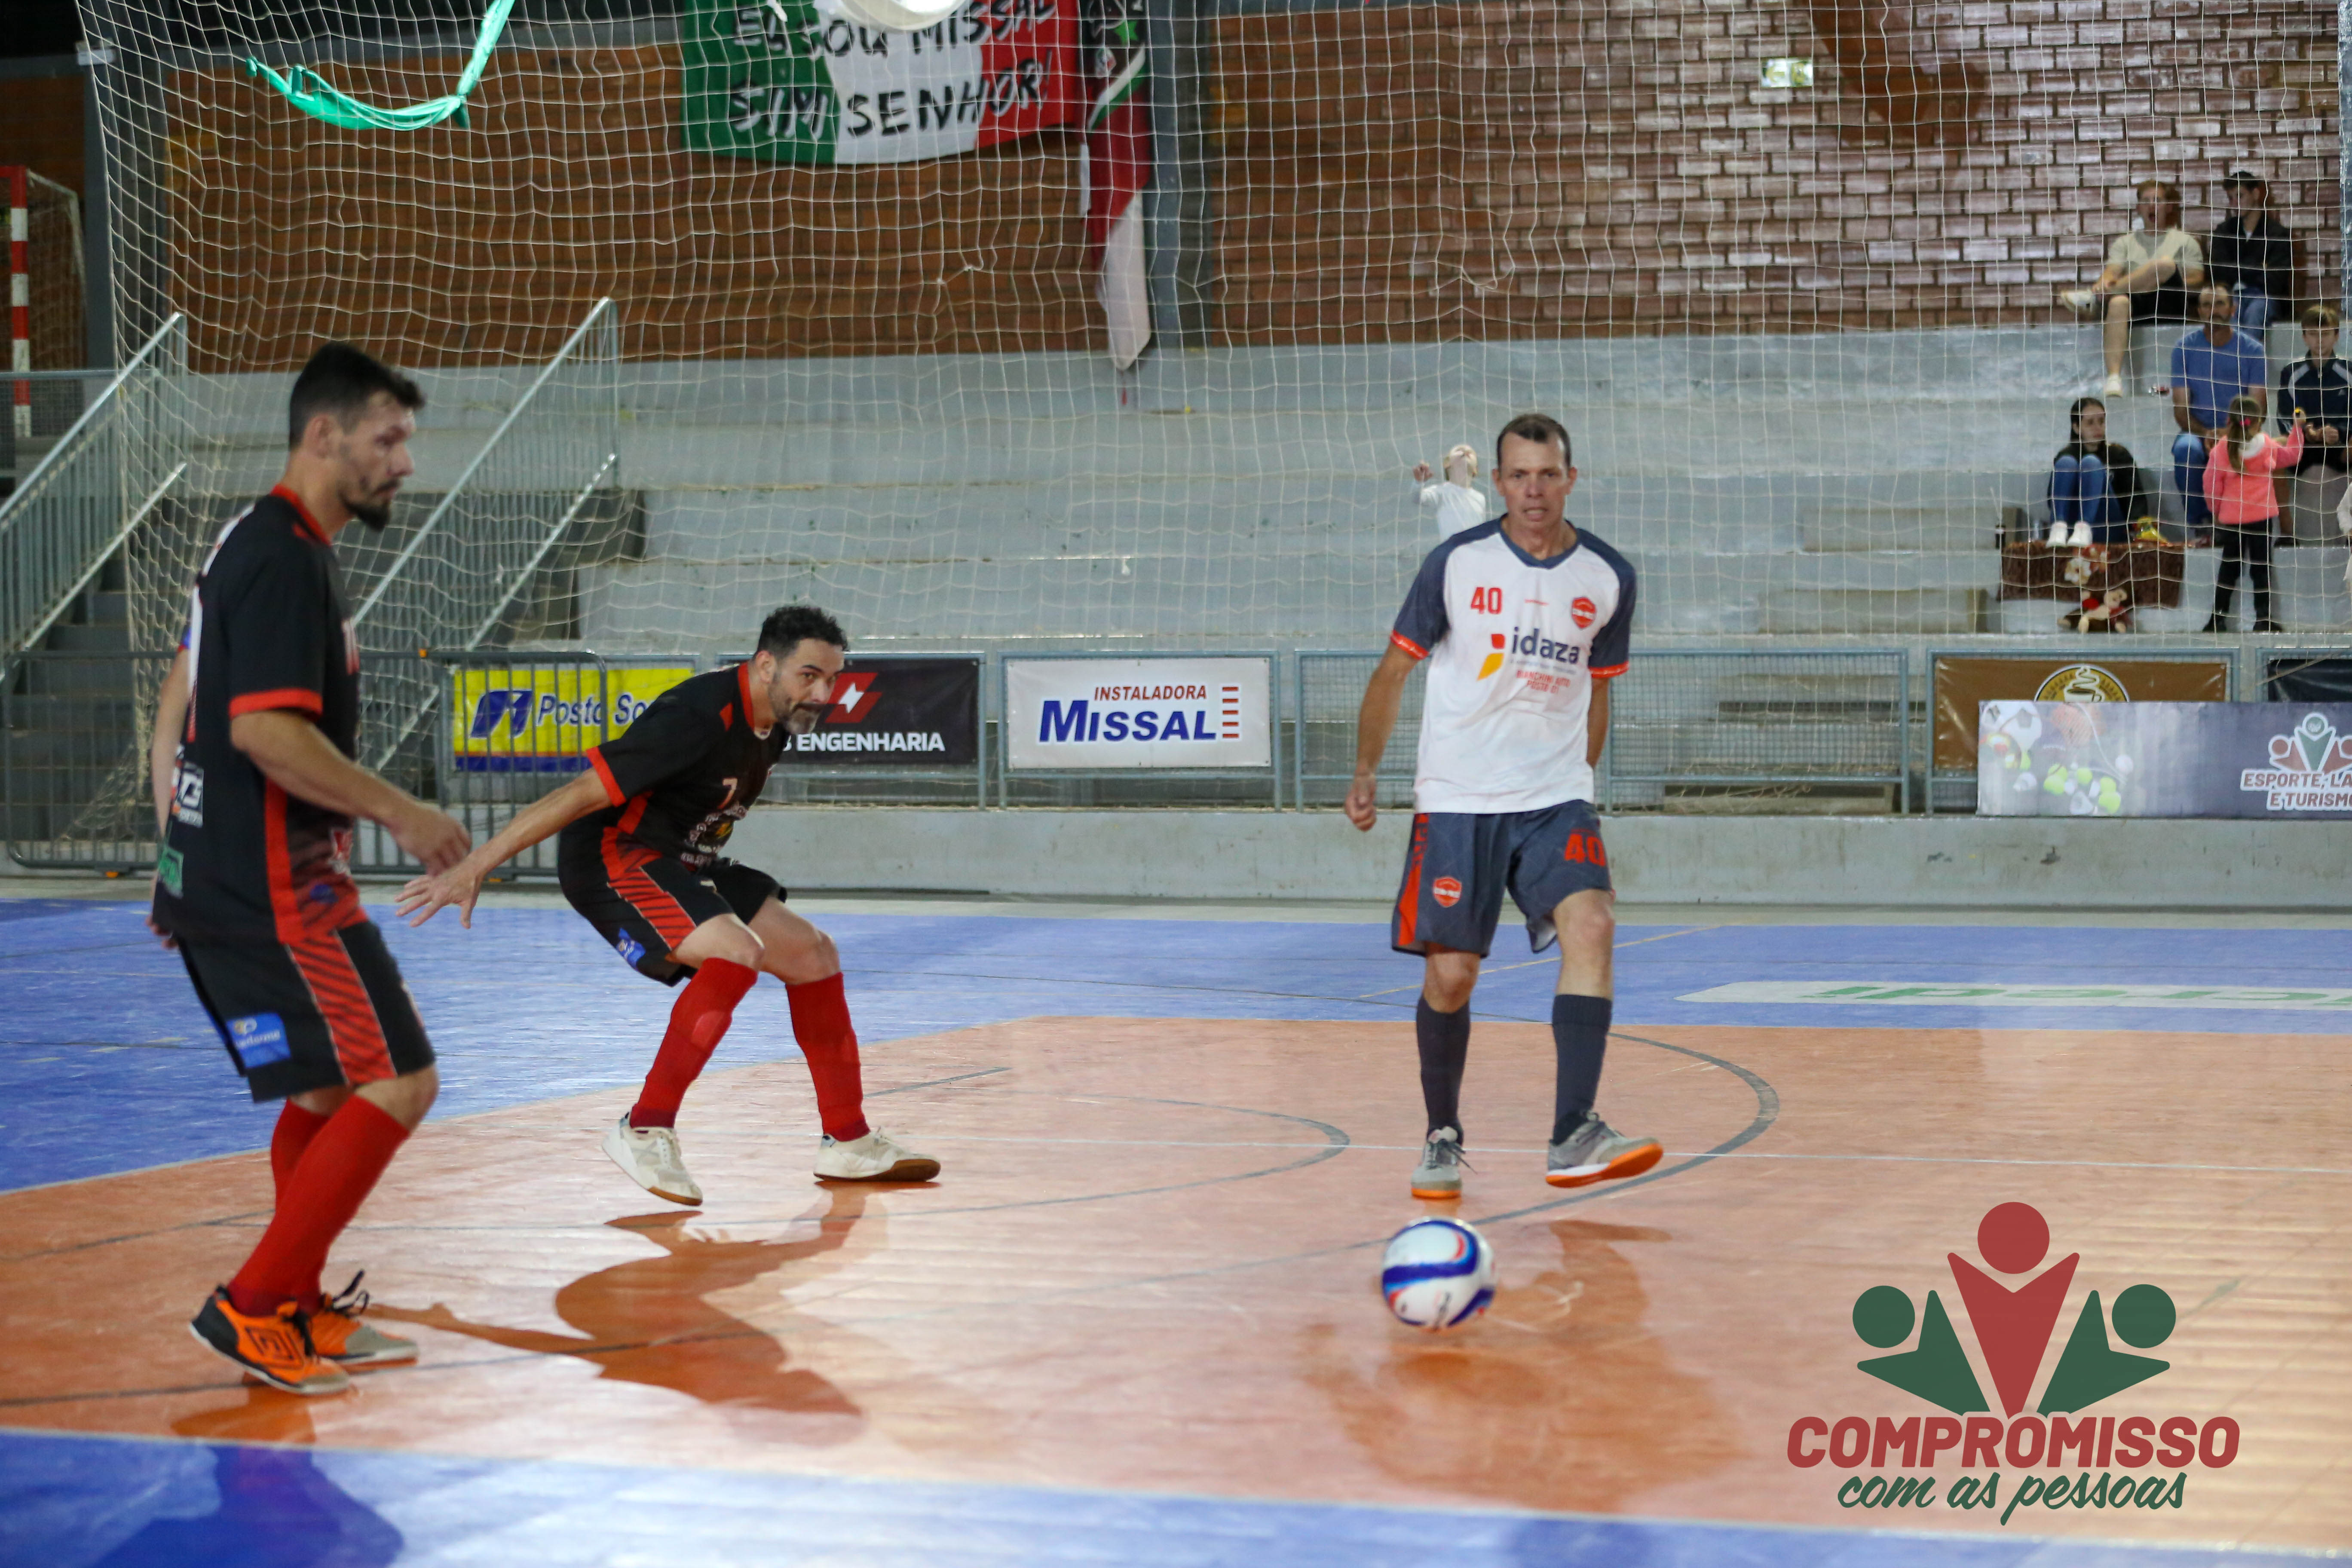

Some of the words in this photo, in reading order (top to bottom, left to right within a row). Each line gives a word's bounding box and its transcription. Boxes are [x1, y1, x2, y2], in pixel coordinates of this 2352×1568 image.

[798, 19, 889, 60] SOU
[731, 81, 827, 138] SIM
[1470, 586, 1502, 615] 40
[1512, 626, 1580, 664] idaza
[1094, 686, 1207, 701] INSTALADORA
[796, 732, 946, 751] ENGENHARIA
[717, 778, 738, 809] 7
[2243, 773, 2325, 790] ESPORTE,
[2270, 793, 2281, 806] E
[1565, 834, 1607, 867] 40
